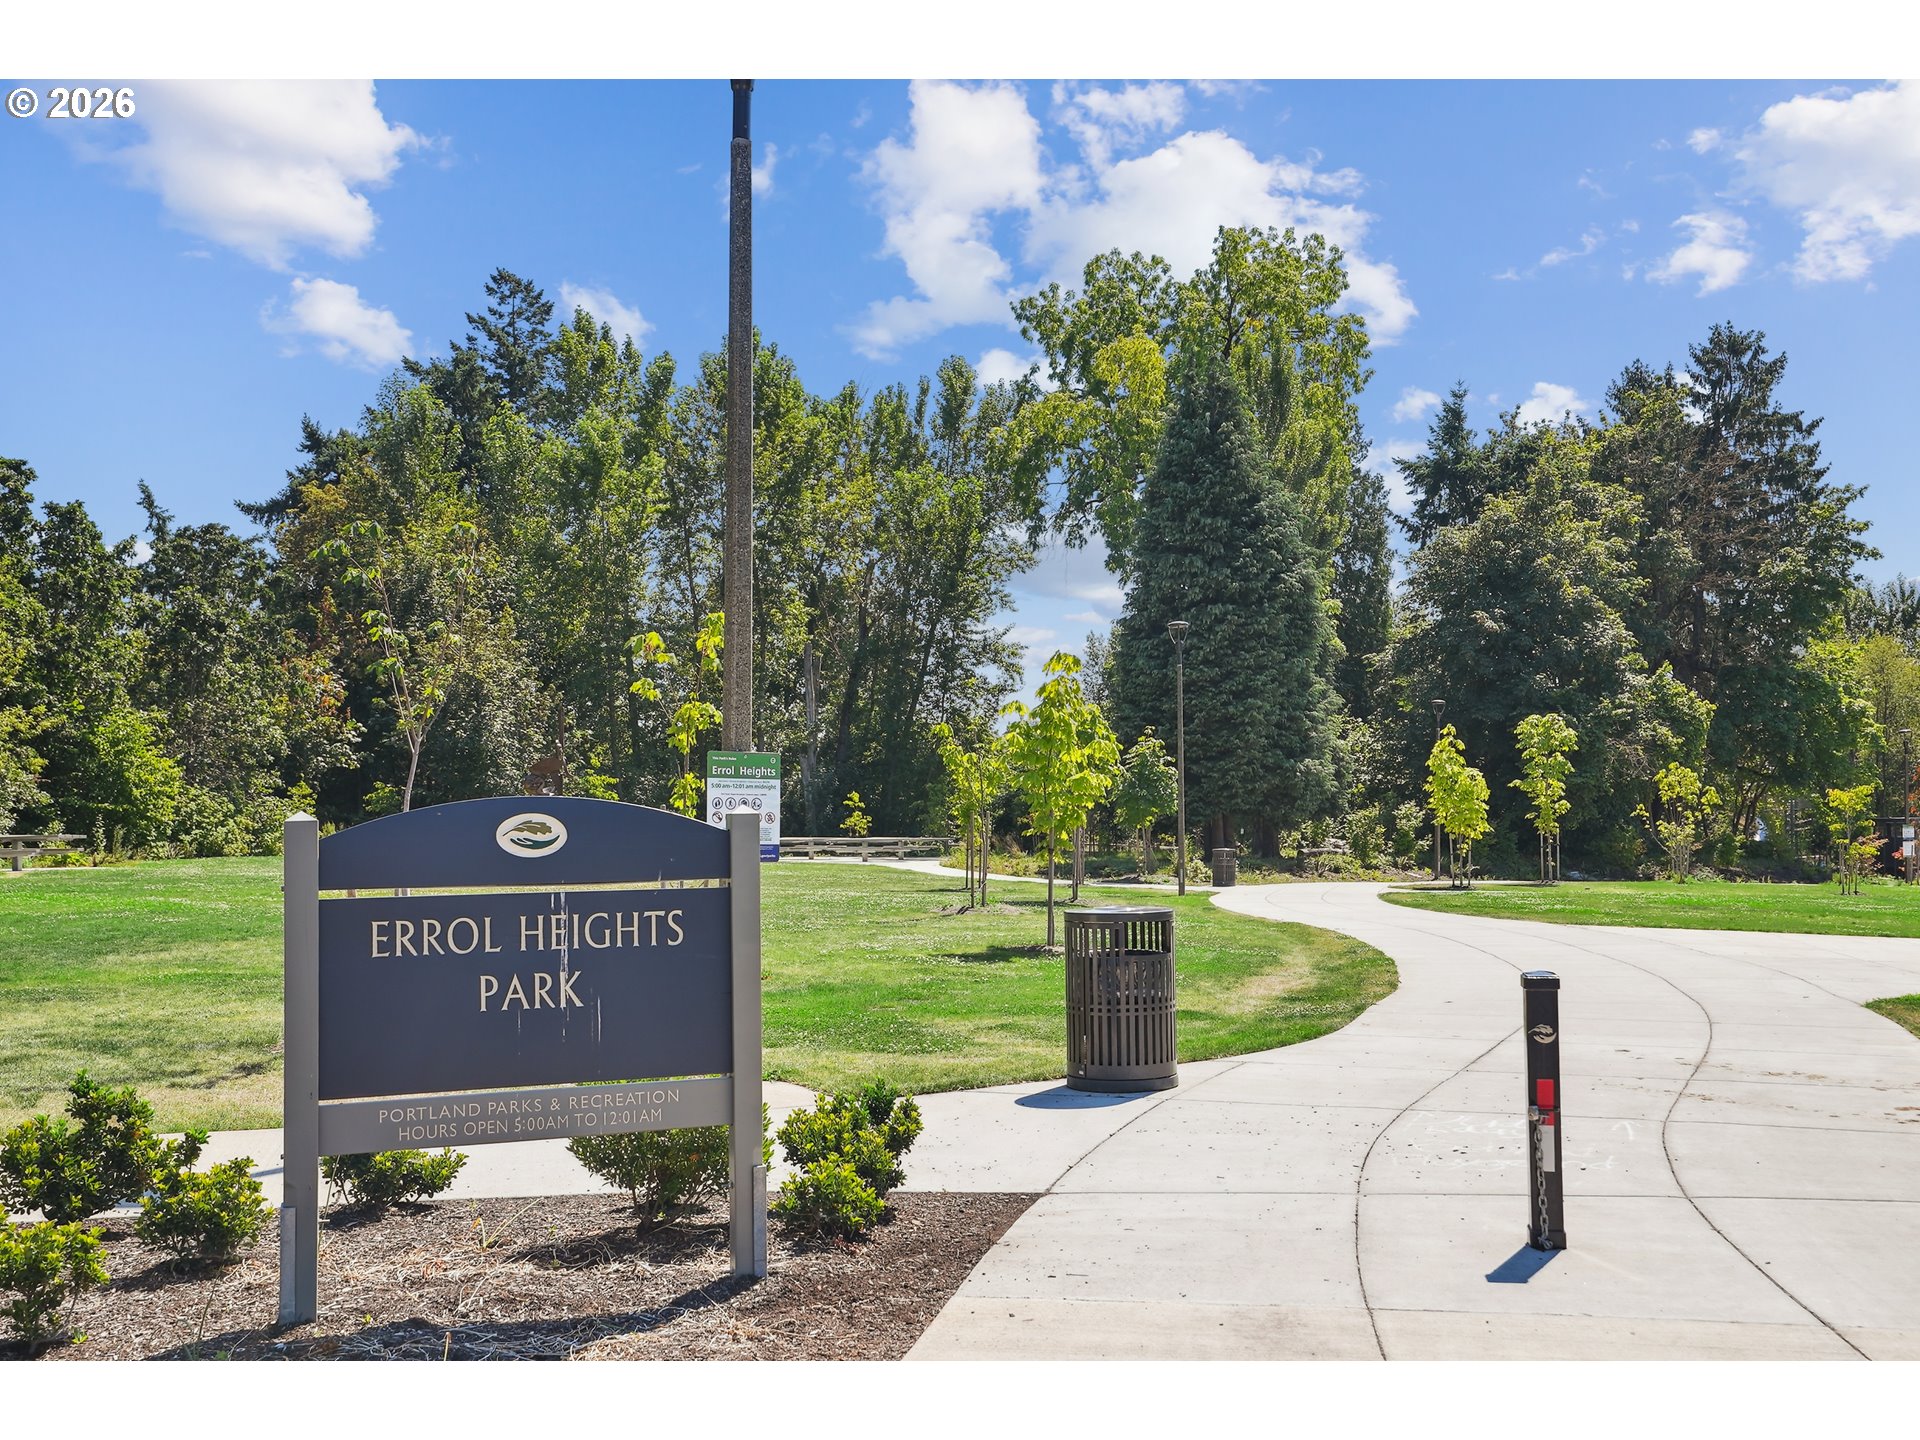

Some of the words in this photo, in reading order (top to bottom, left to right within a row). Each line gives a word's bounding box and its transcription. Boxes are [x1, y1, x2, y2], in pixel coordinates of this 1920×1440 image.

[712, 765, 735, 775] Errol
[740, 766, 776, 778] Heights
[371, 916, 502, 959] ERROL
[519, 909, 685, 952] HEIGHTS
[478, 970, 584, 1013] PARK
[379, 1103, 481, 1123] PORTLAND
[488, 1098, 542, 1116] PARKS
[550, 1098, 561, 1110] &
[569, 1089, 680, 1109] RECREATION
[399, 1122, 458, 1141] HOURS
[463, 1117, 509, 1136] OPEN
[514, 1113, 569, 1132] 5:00AM
[574, 1111, 597, 1128] TO
[603, 1108, 663, 1126] 12:01AM
